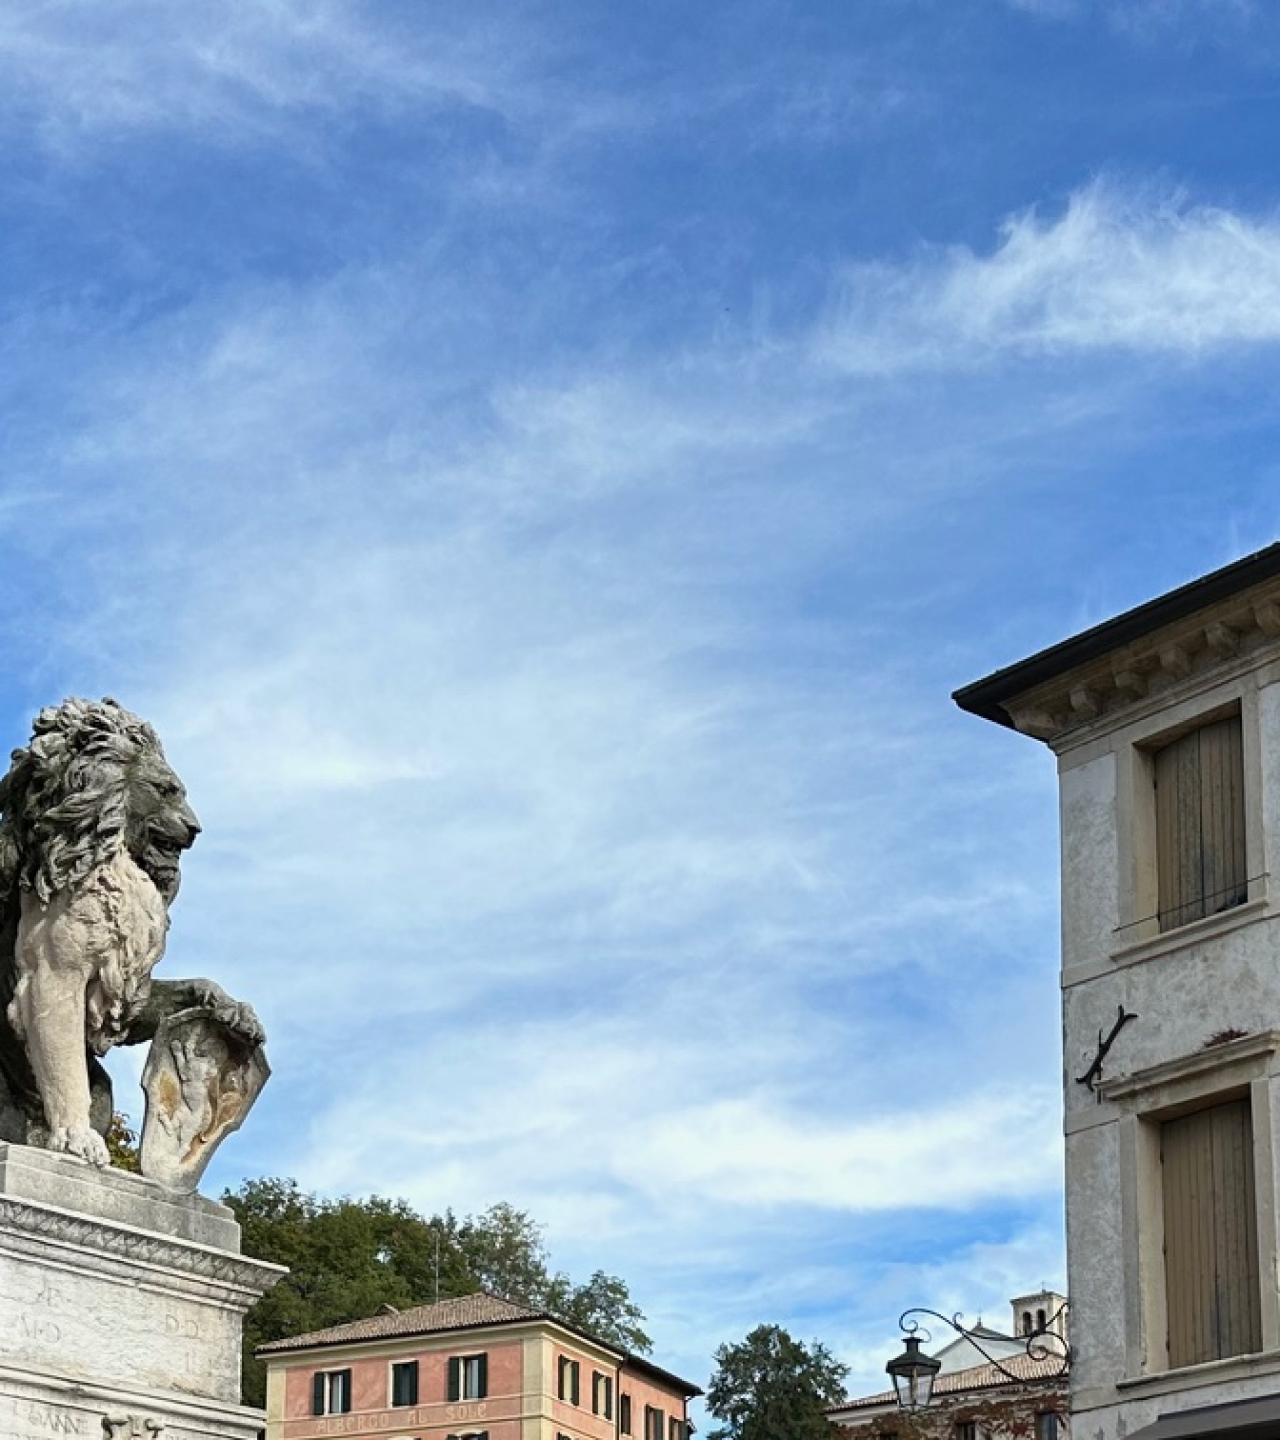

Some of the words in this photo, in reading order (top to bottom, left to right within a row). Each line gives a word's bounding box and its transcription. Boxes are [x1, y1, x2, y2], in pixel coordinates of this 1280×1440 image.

[318, 1413, 389, 1433] ALBERGO
[408, 1410, 429, 1426] AL
[446, 1403, 487, 1421] SOLE
